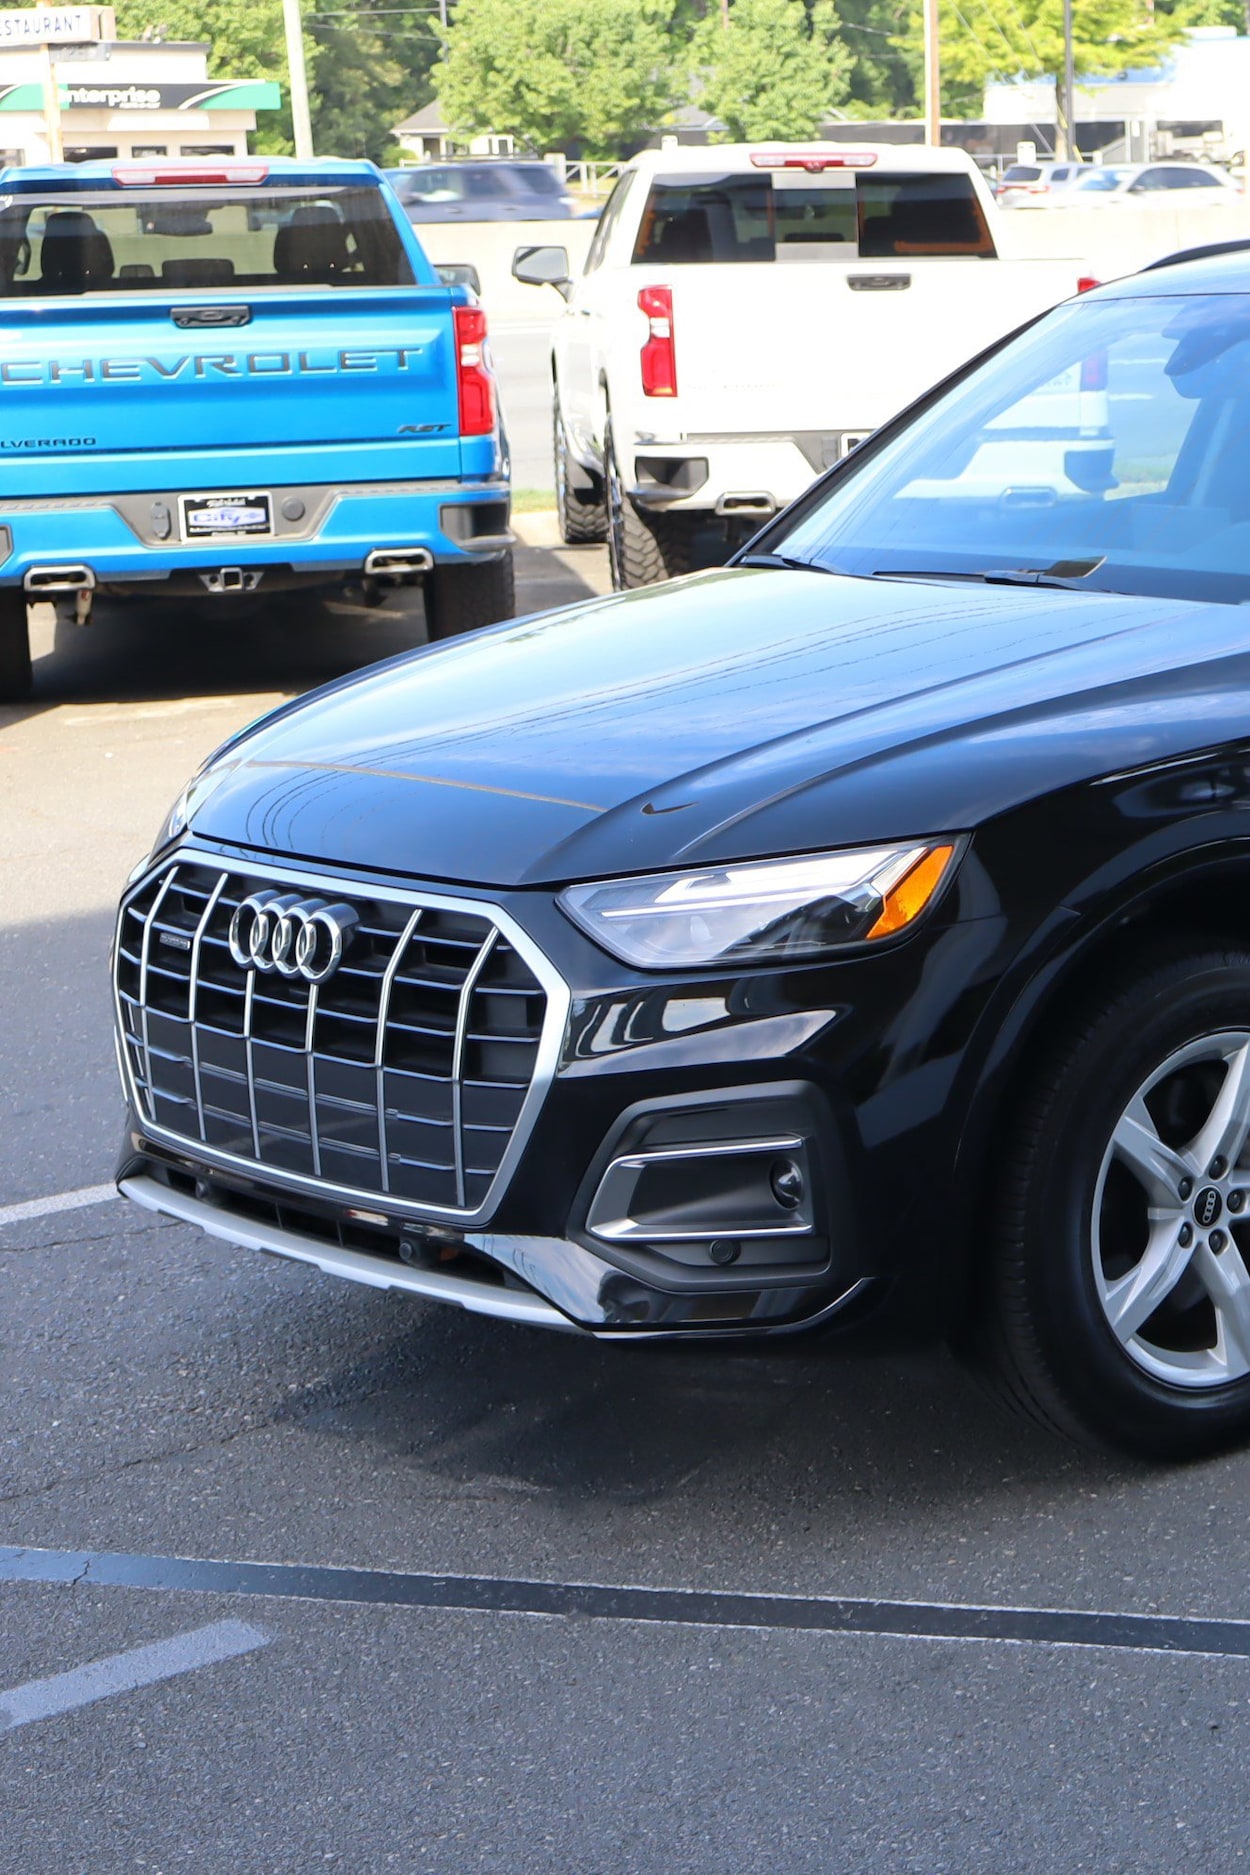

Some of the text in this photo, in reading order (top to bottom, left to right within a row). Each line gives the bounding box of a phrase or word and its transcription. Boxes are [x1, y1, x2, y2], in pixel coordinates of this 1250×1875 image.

[0, 14, 81, 37] STAURANT
[0, 348, 424, 386] CHEVROLET
[397, 423, 453, 434] RST
